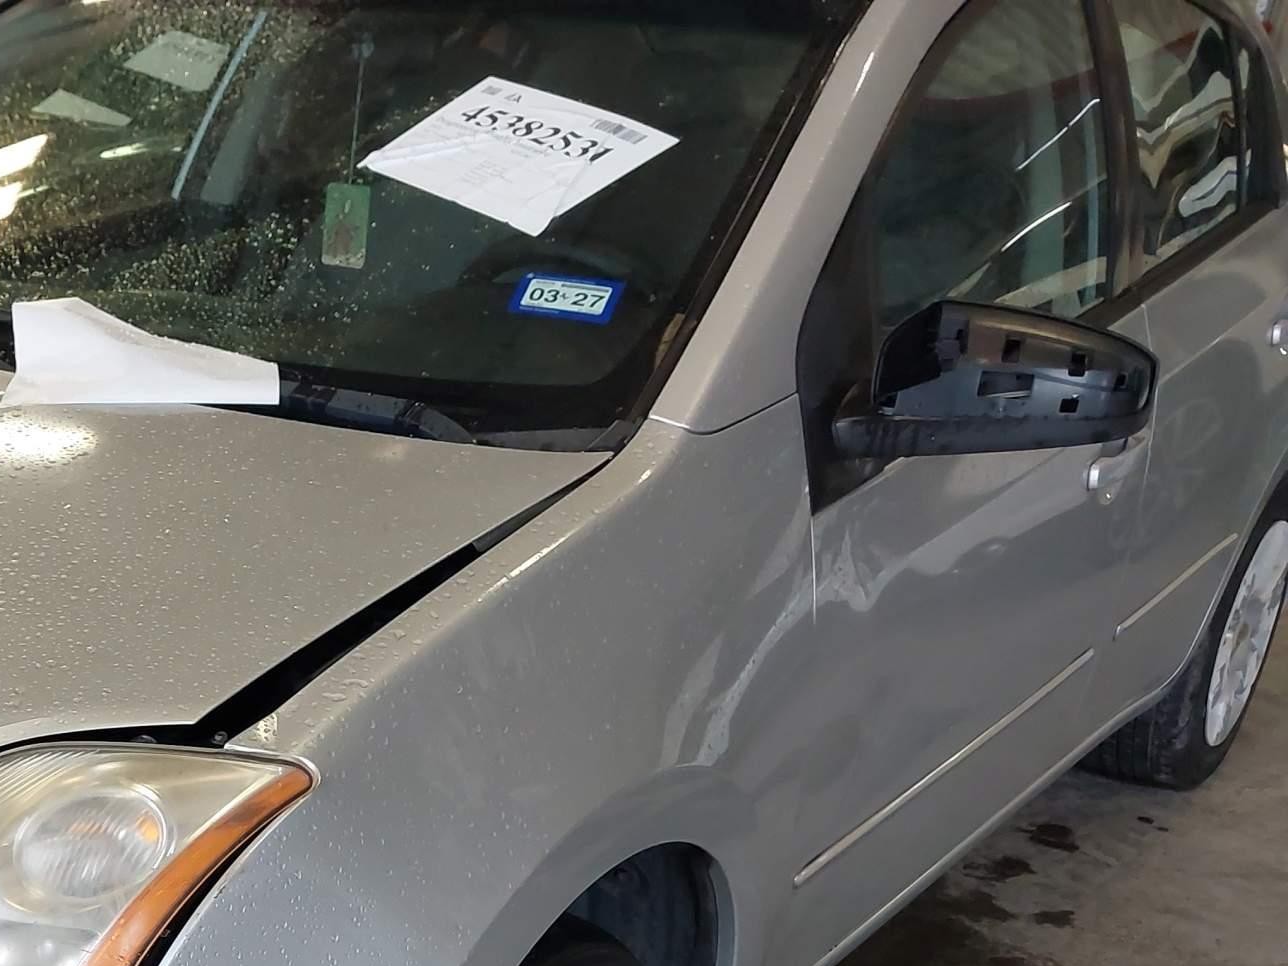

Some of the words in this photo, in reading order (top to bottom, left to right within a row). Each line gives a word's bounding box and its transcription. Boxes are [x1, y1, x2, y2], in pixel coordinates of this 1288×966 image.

[461, 105, 615, 164] 45382531
[529, 287, 560, 303] 03
[570, 292, 606, 308] 27
